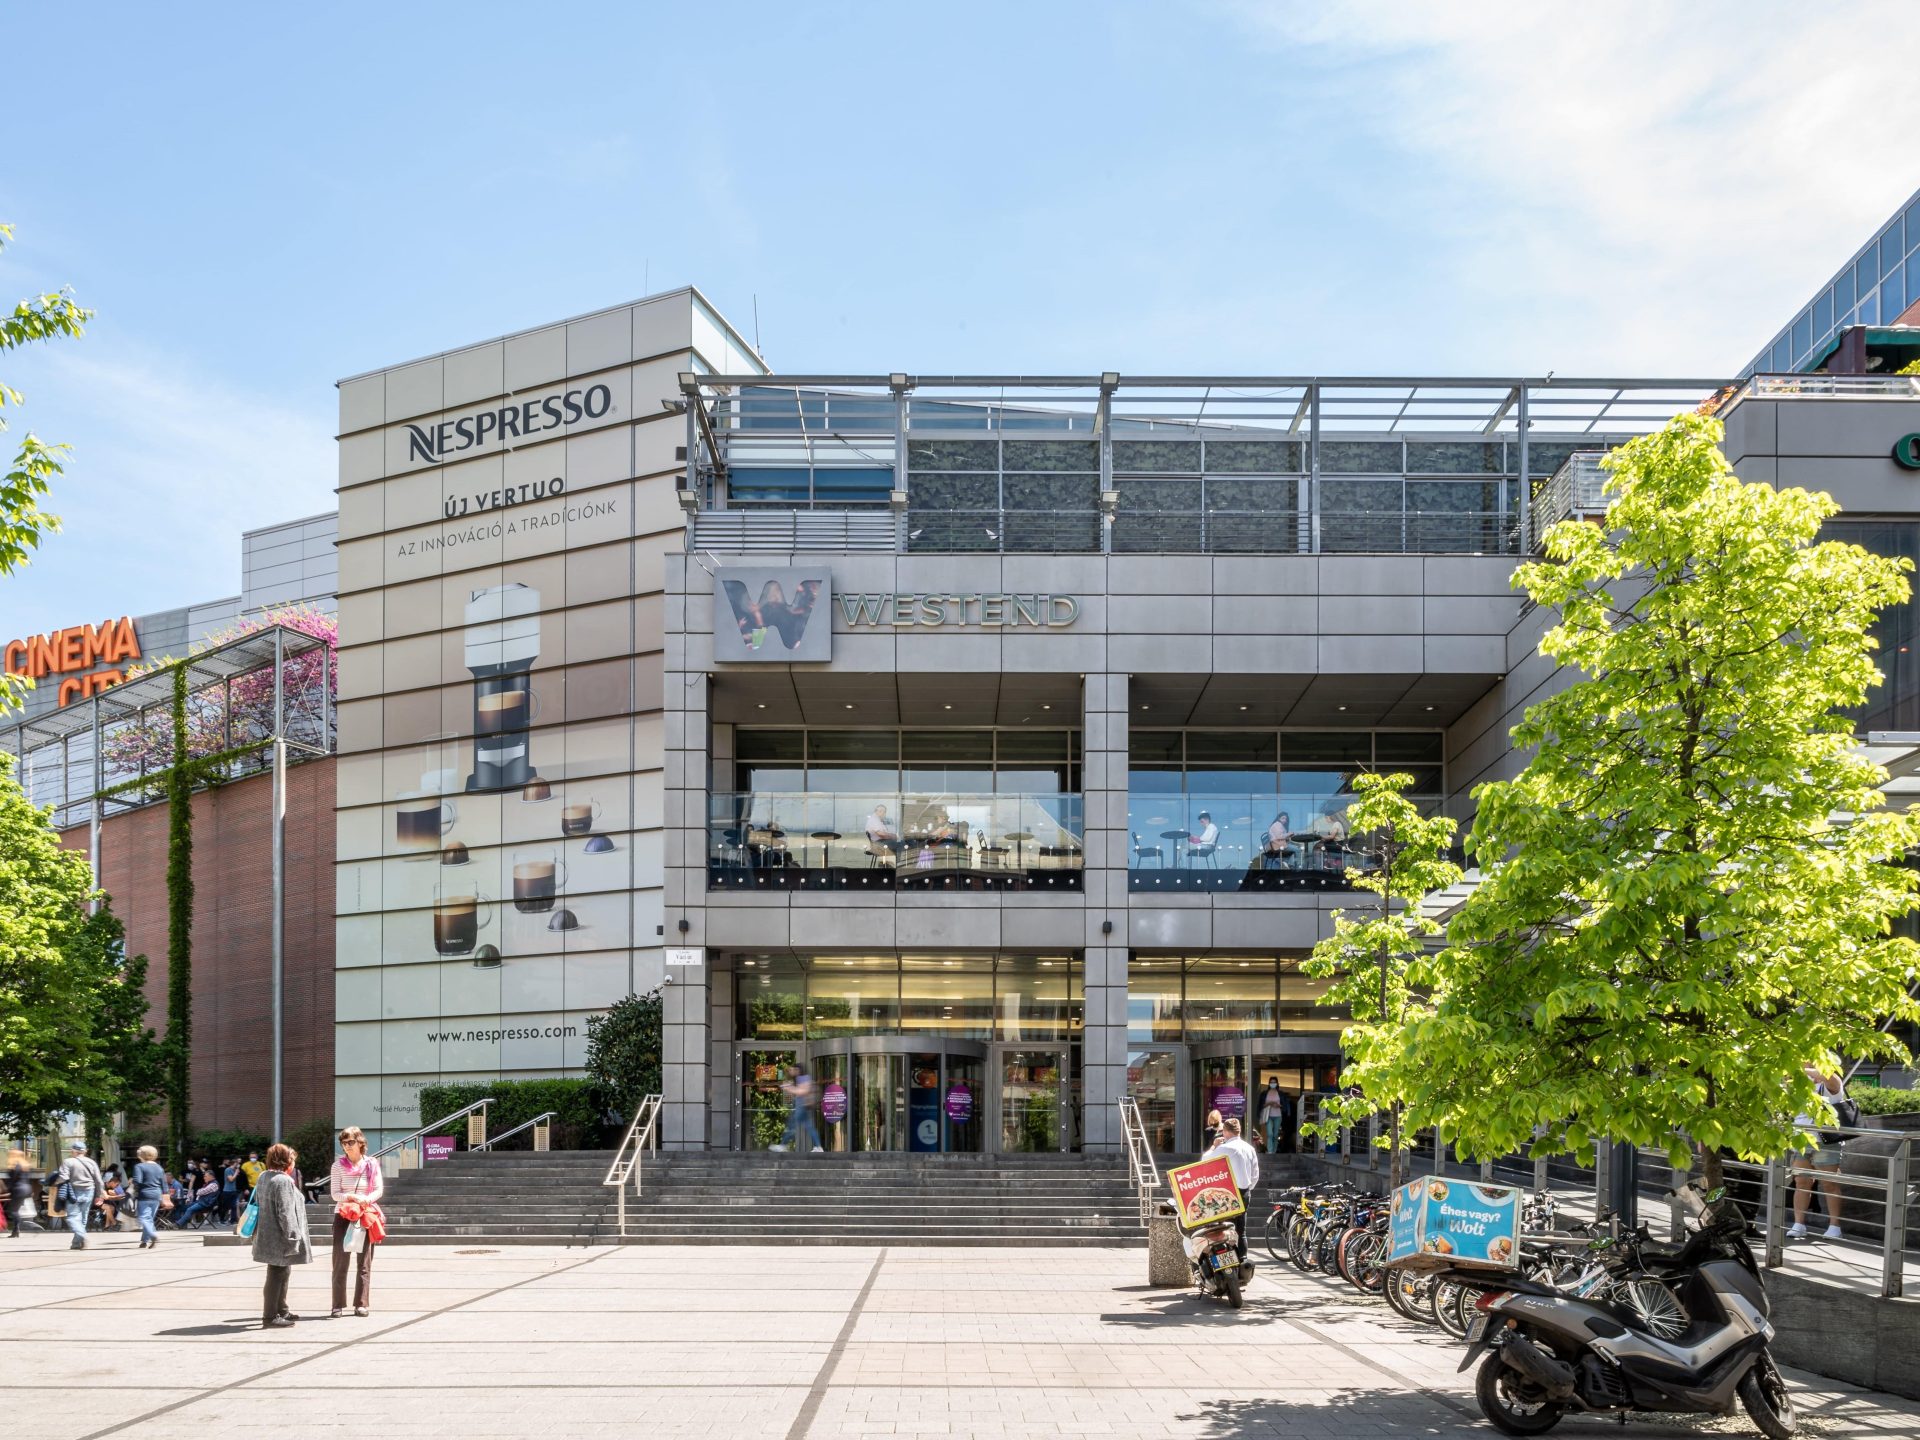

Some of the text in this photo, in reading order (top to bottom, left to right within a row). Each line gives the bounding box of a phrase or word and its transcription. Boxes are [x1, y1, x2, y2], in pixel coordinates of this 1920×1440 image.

[401, 384, 611, 463] NESPRESSO
[444, 477, 565, 518] ÚJ VERTUO
[398, 500, 617, 557] AZ INNOVÁCIÓ A TRADÍCIÓNK
[838, 592, 1080, 627] WESTEND
[4, 615, 142, 679] CINEMA
[57, 668, 130, 709] CIT
[427, 1024, 577, 1044] www.nespresso.com
[408, 1080, 428, 1089] képen
[373, 1104, 393, 1113] Nestlé
[1179, 1170, 1229, 1191] NetPincér
[1440, 1203, 1501, 1223] Éhes vagy?
[1449, 1220, 1486, 1236] Wolt
